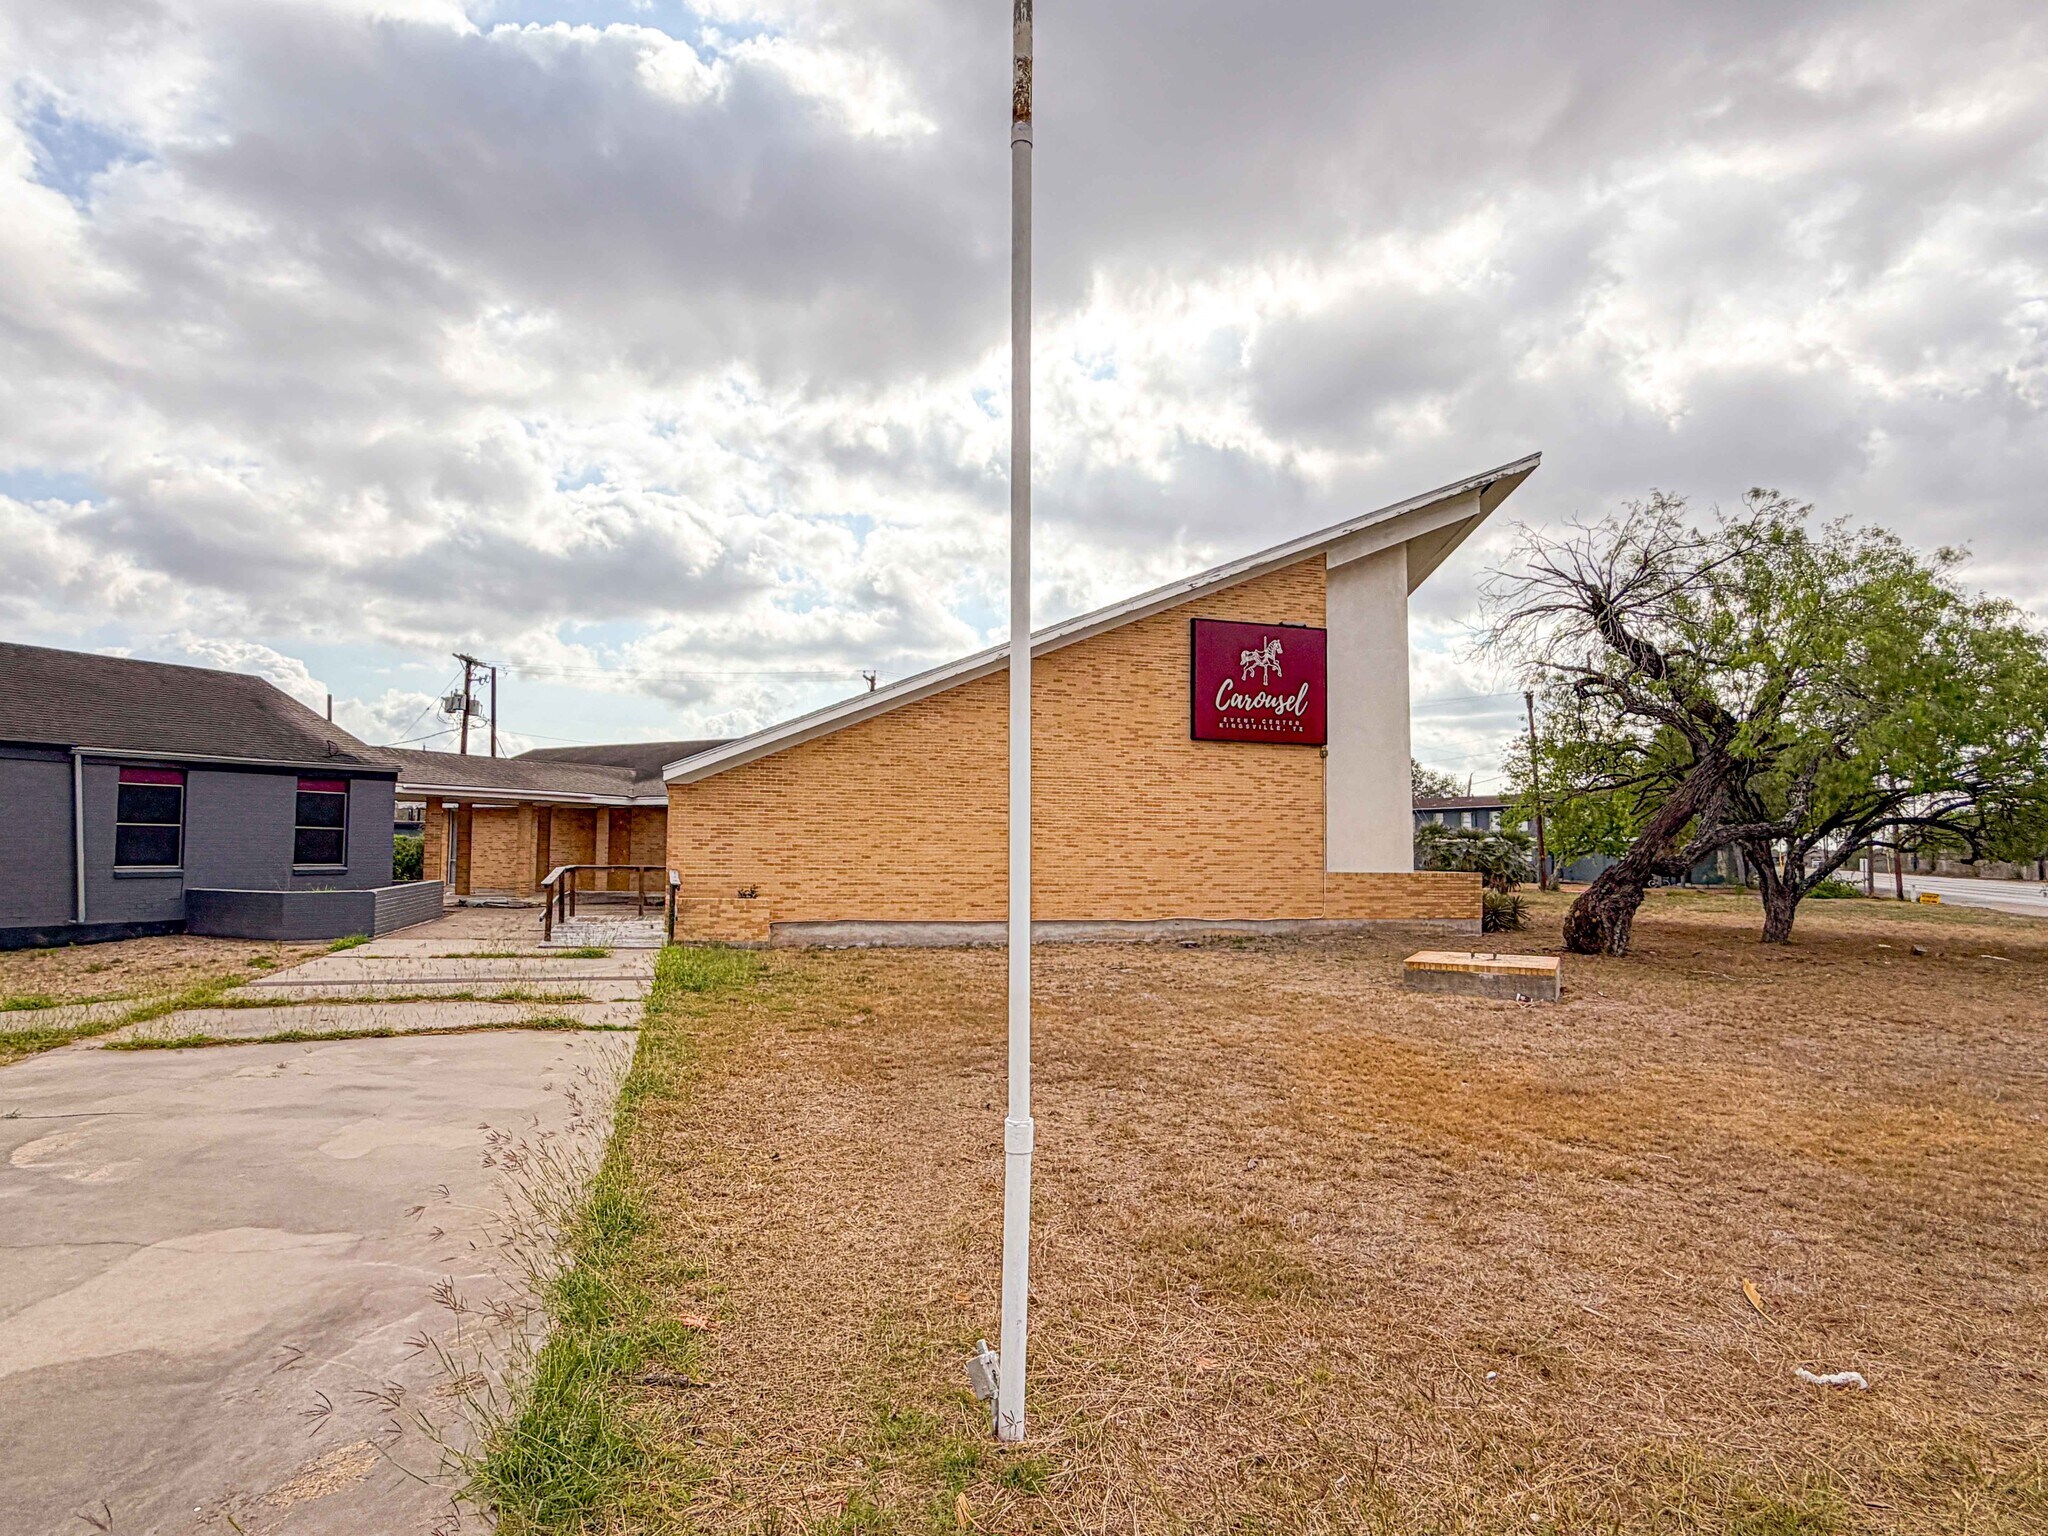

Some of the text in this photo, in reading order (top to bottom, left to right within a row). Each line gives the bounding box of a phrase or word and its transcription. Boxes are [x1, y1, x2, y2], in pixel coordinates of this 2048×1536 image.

[1215, 678, 1309, 716] Carousel
[1223, 716, 1300, 726] EVENT CENTER
